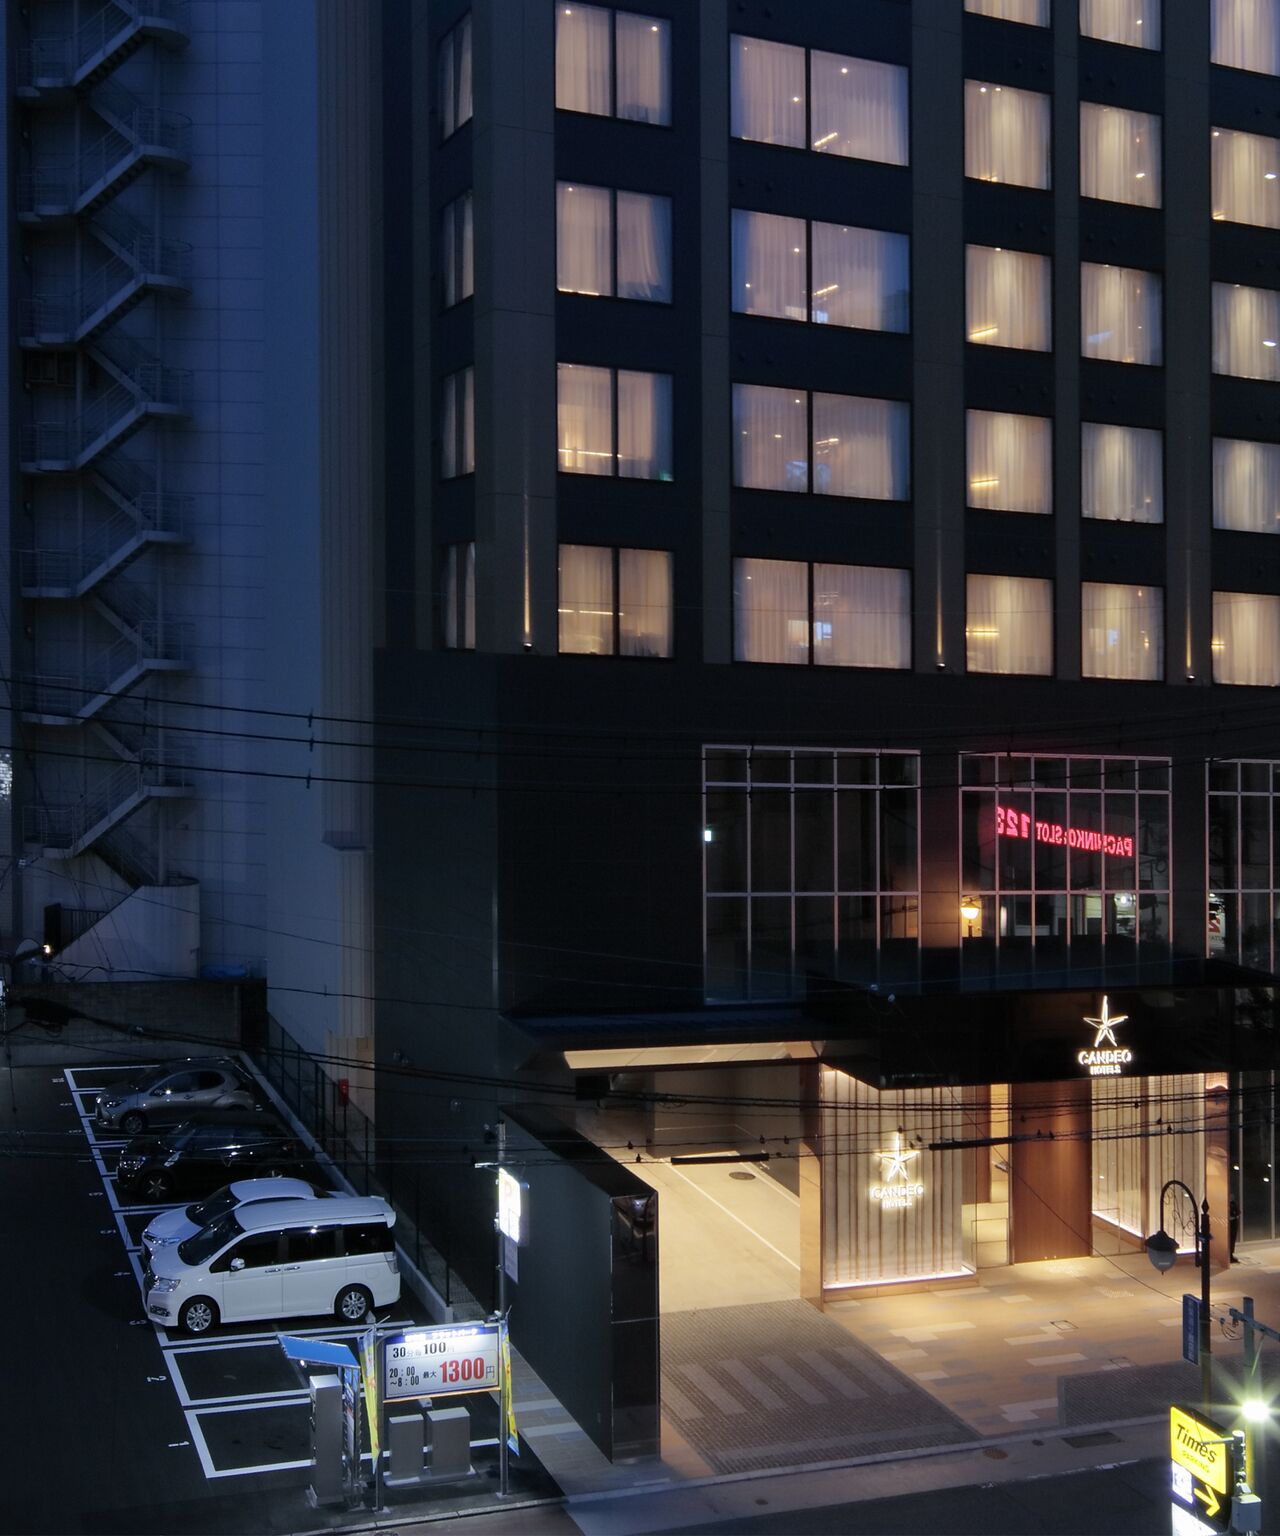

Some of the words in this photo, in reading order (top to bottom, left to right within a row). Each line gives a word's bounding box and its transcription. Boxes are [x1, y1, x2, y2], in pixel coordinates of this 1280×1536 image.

[1078, 1049, 1132, 1065] CANDEO
[1089, 1064, 1121, 1076] HOTELS
[870, 1184, 924, 1201] CANDEO
[1177, 1423, 1217, 1463] Times
